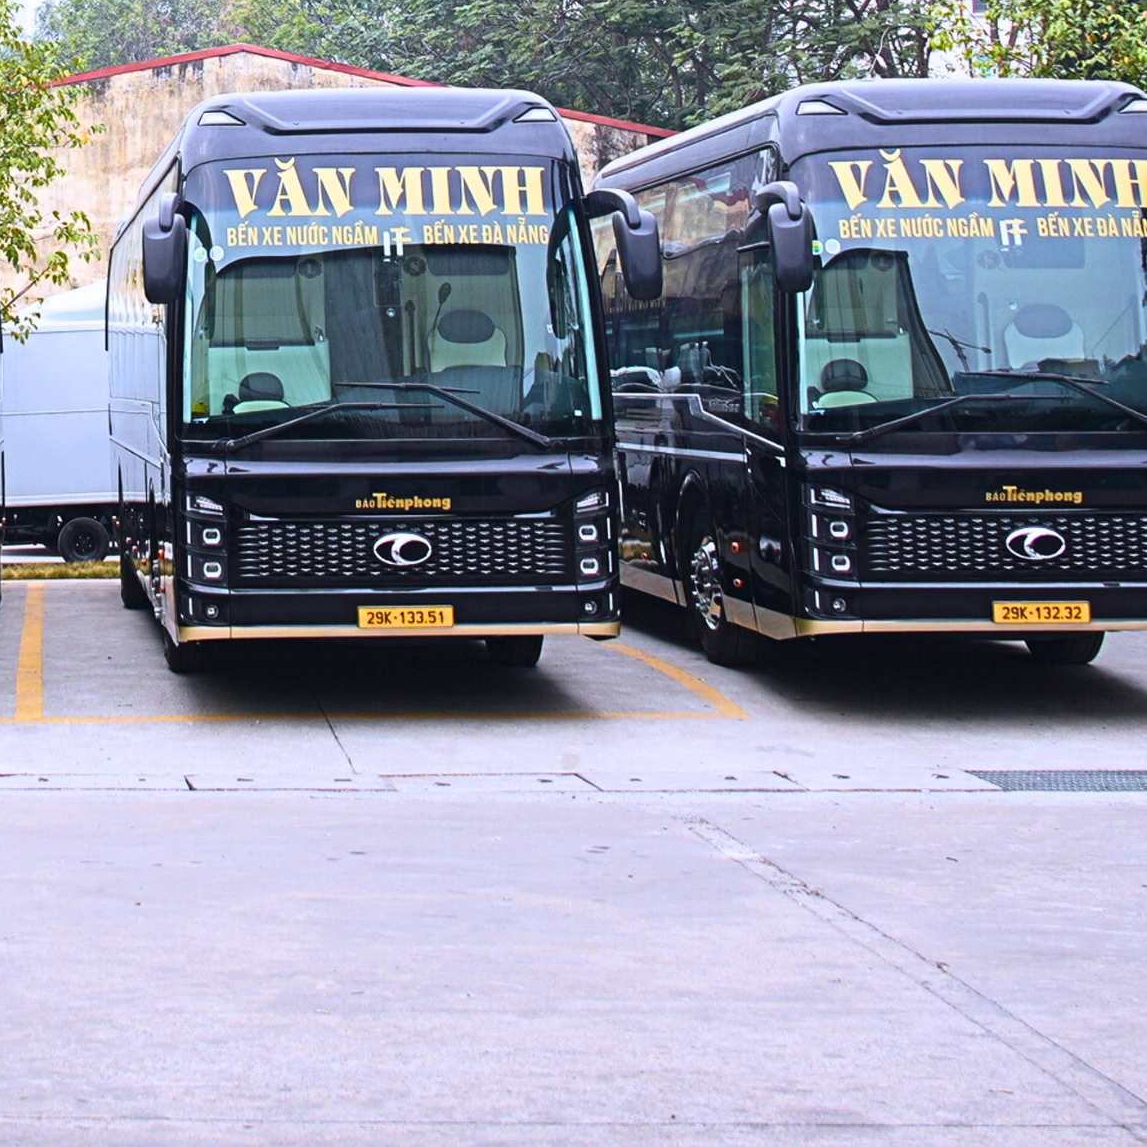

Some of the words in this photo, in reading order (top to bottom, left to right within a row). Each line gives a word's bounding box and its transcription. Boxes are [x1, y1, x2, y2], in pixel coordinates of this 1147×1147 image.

[223, 157, 356, 218] VĂN
[375, 166, 548, 217] MINH
[828, 149, 966, 211] VĂN
[227, 220, 258, 246] BẾN
[262, 227, 283, 246] XE
[286, 222, 328, 245] NƯỚC
[423, 219, 454, 245] BẾN
[458, 225, 479, 244] XE
[482, 220, 503, 244] ĐÀ
[839, 213, 872, 238] BẾN
[875, 219, 897, 238] XE
[900, 214, 943, 238] NƯỚC
[1037, 212, 1070, 237] BẾN
[1072, 217, 1095, 237] XE
[1096, 213, 1119, 237] ĐÀ
[366, 611, 444, 625] 29K-133.51
[1002, 606, 1082, 620] 29K-132.32
